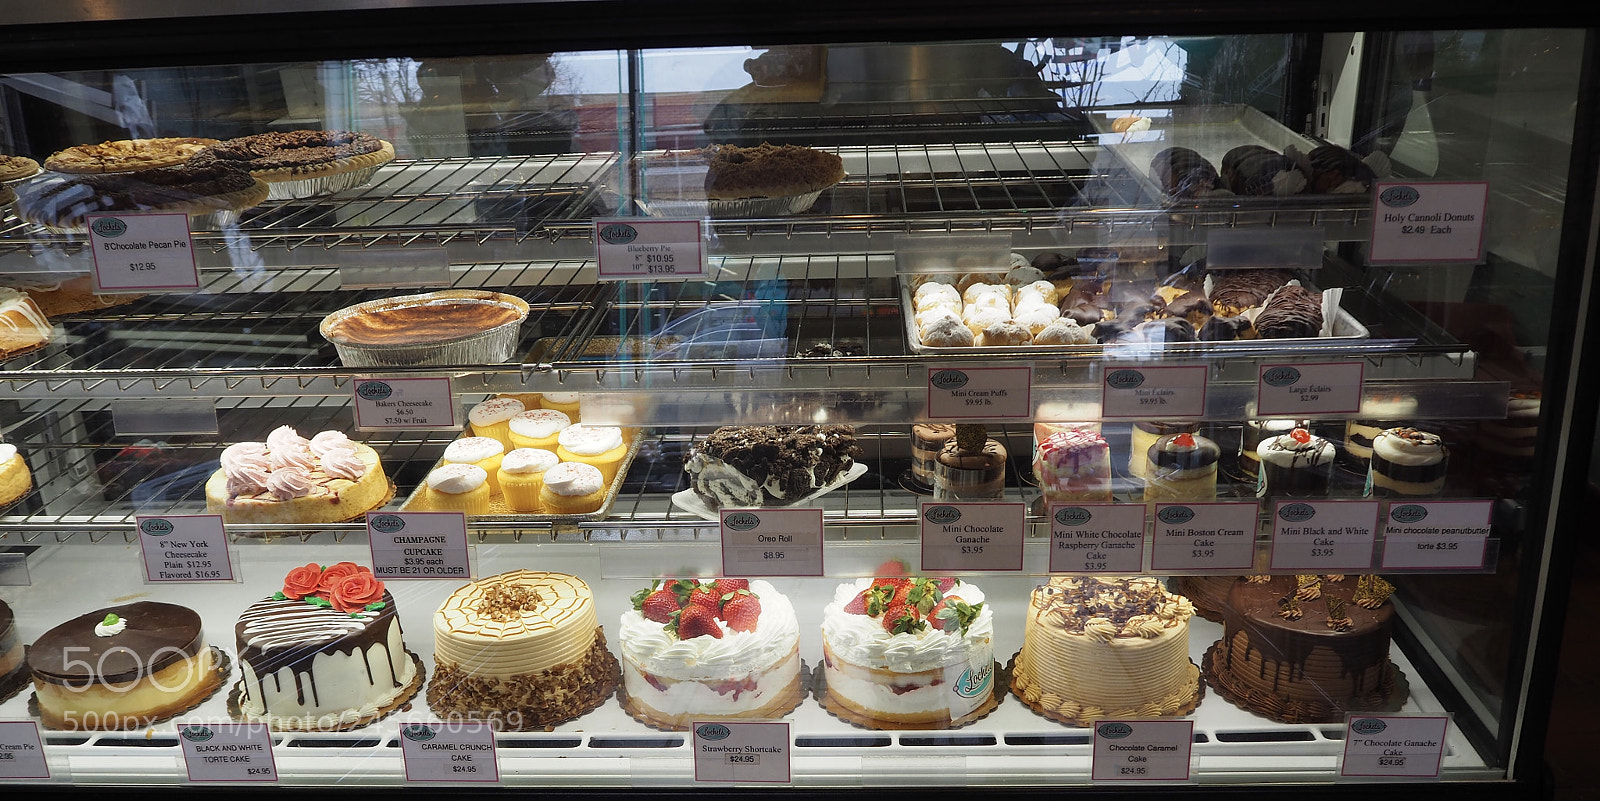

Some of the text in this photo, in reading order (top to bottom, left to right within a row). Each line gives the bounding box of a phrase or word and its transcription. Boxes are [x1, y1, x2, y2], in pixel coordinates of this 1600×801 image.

[1384, 213, 1474, 223] Holy Cannoli Donuts
[1402, 226, 1452, 234] $2.49 Each
[174, 240, 186, 248] Pie
[130, 263, 156, 271] $12.95
[648, 265, 675, 273] $13.95
[1442, 527, 1490, 535] peanutbutter
[1059, 542, 1099, 550] Raspberry
[702, 745, 742, 754] Strawberry
